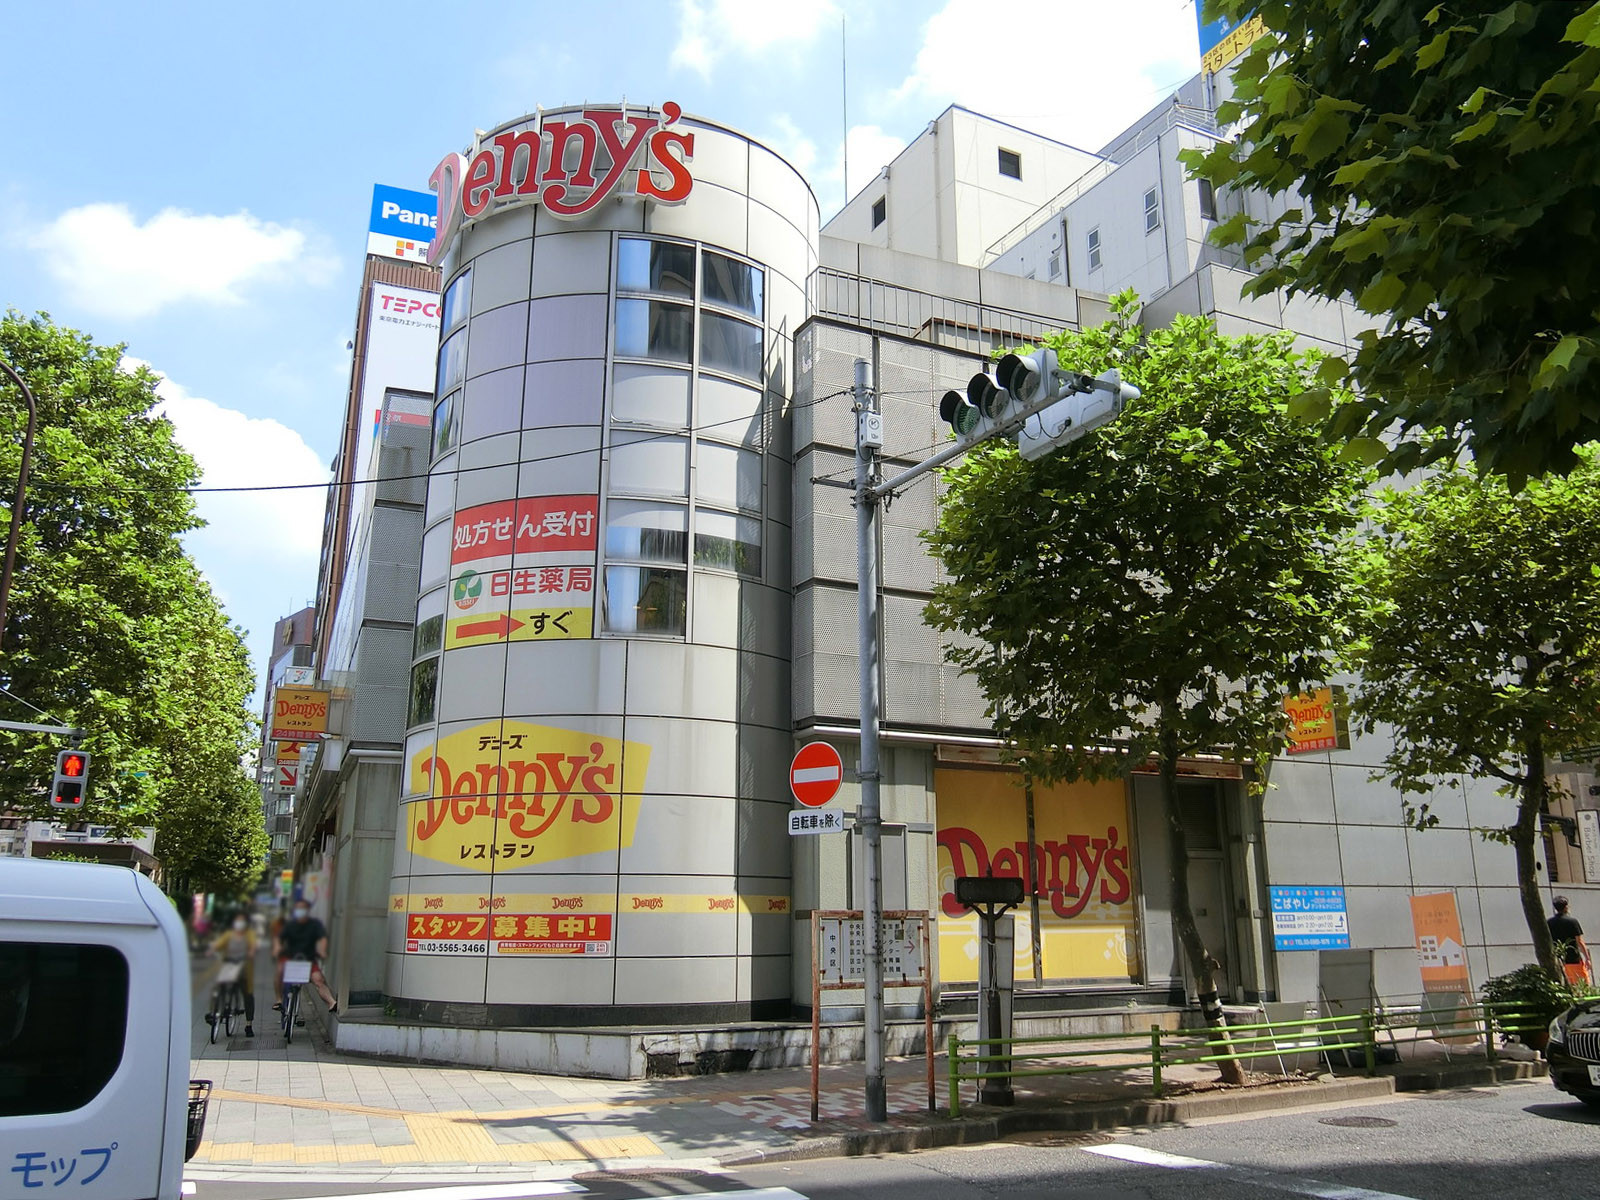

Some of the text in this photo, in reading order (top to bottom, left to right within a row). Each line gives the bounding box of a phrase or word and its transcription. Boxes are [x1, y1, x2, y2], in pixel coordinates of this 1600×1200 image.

[426, 101, 695, 265] Denny's
[454, 510, 595, 551] 処方せん受付
[490, 567, 592, 597] 日生薬局
[529, 610, 573, 635] すぐ
[277, 700, 326, 719] Denny's
[478, 734, 528, 751] デニーズ
[416, 742, 616, 841] Denny's
[791, 813, 840, 830] 自転車を除く
[460, 843, 535, 859] レストラン
[937, 826, 1131, 919] Denny's
[552, 896, 584, 909] Denny's
[1274, 897, 1311, 910] こばやし
[427, 943, 486, 953] 03-5565-3466
[11, 1141, 119, 1188] モップ
